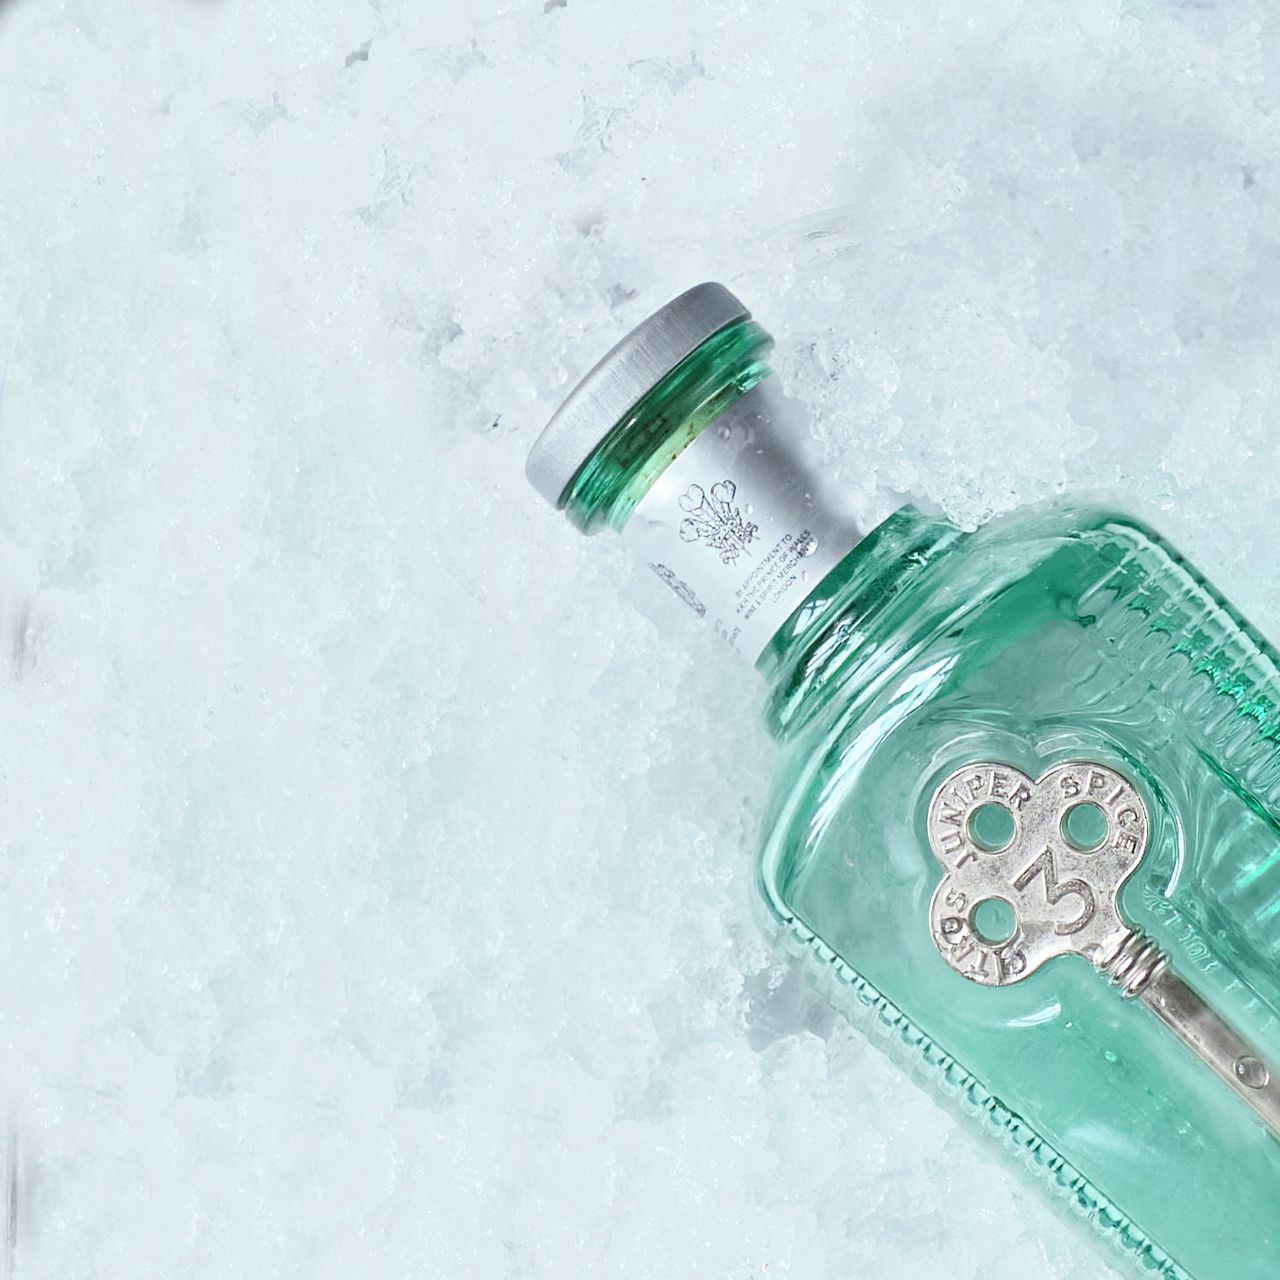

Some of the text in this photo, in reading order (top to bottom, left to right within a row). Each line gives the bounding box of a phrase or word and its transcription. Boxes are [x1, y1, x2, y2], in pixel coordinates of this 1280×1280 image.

[778, 551, 789, 563] OF
[789, 528, 812, 553] WALES
[780, 533, 793, 545] TO
[939, 773, 1031, 869] JUNIPER
[1058, 770, 1139, 855] SPICE
[1012, 844, 1096, 936] 3
